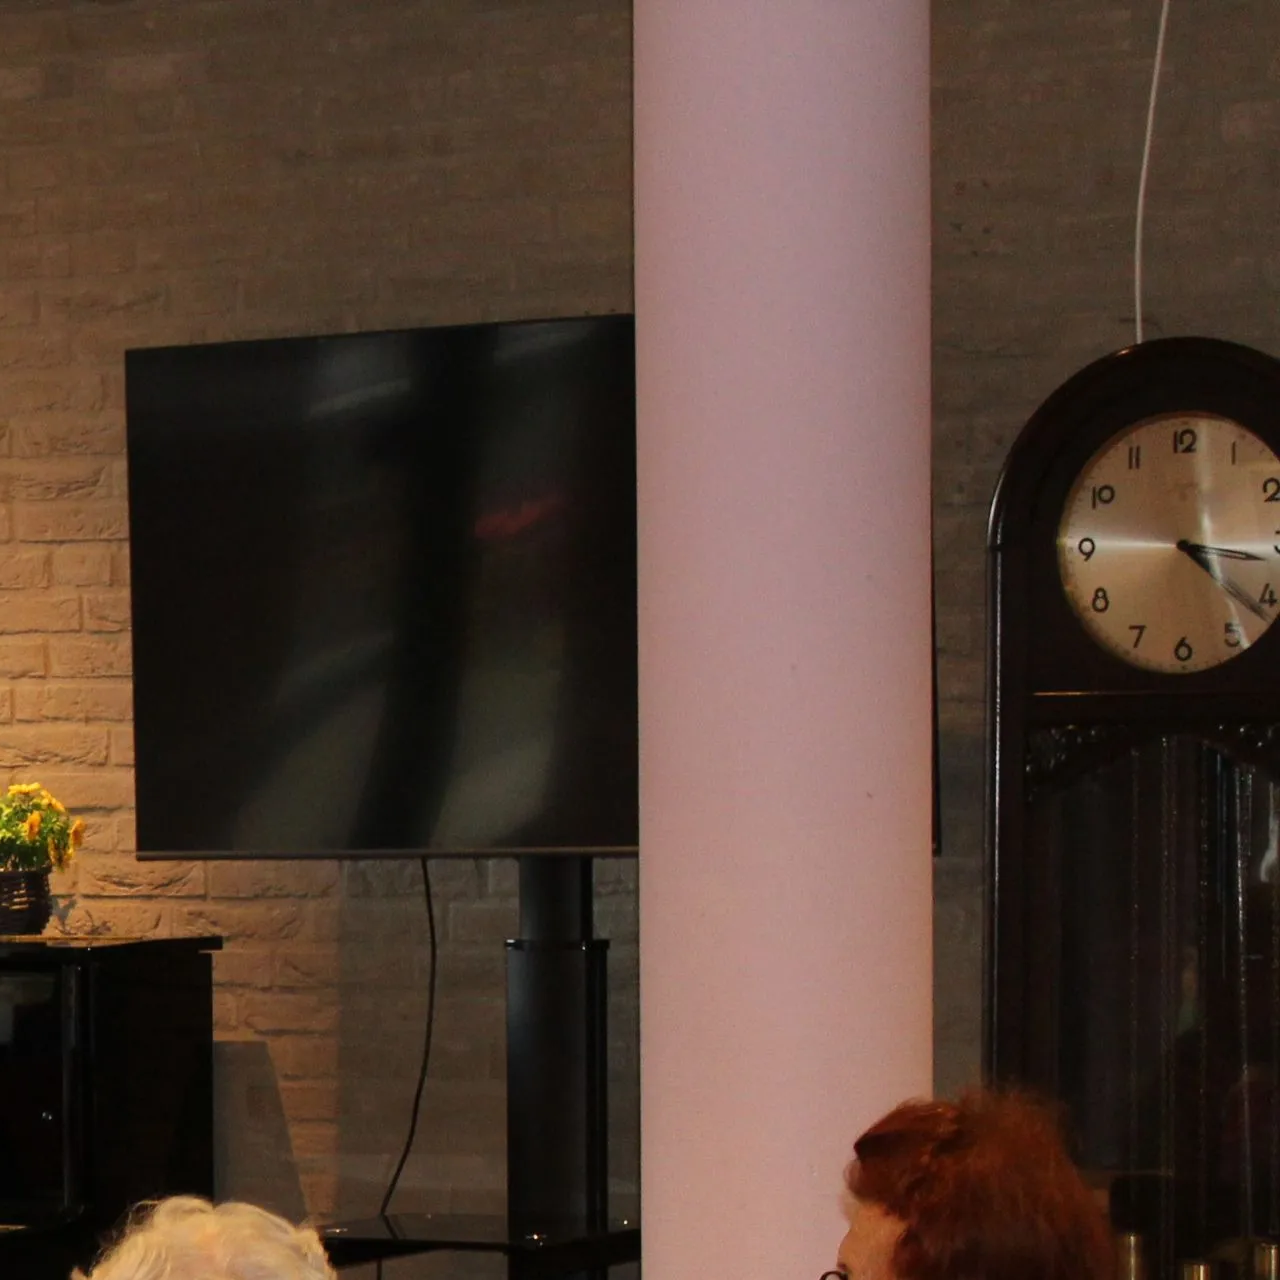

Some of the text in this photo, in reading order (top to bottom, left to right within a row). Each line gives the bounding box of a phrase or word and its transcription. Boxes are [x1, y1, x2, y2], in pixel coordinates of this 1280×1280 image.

[1173, 428, 1197, 454] 12
[1230, 440, 1237, 466] 1
[1128, 445, 1140, 470] 11
[1092, 484, 1116, 509] 10
[1262, 477, 1280, 503] 2
[1078, 537, 1096, 562] 9
[1091, 587, 1110, 613] 8
[1258, 582, 1278, 607] 4
[1128, 624, 1147, 648] 7
[1224, 621, 1241, 647] 5
[1174, 637, 1193, 662] 6
